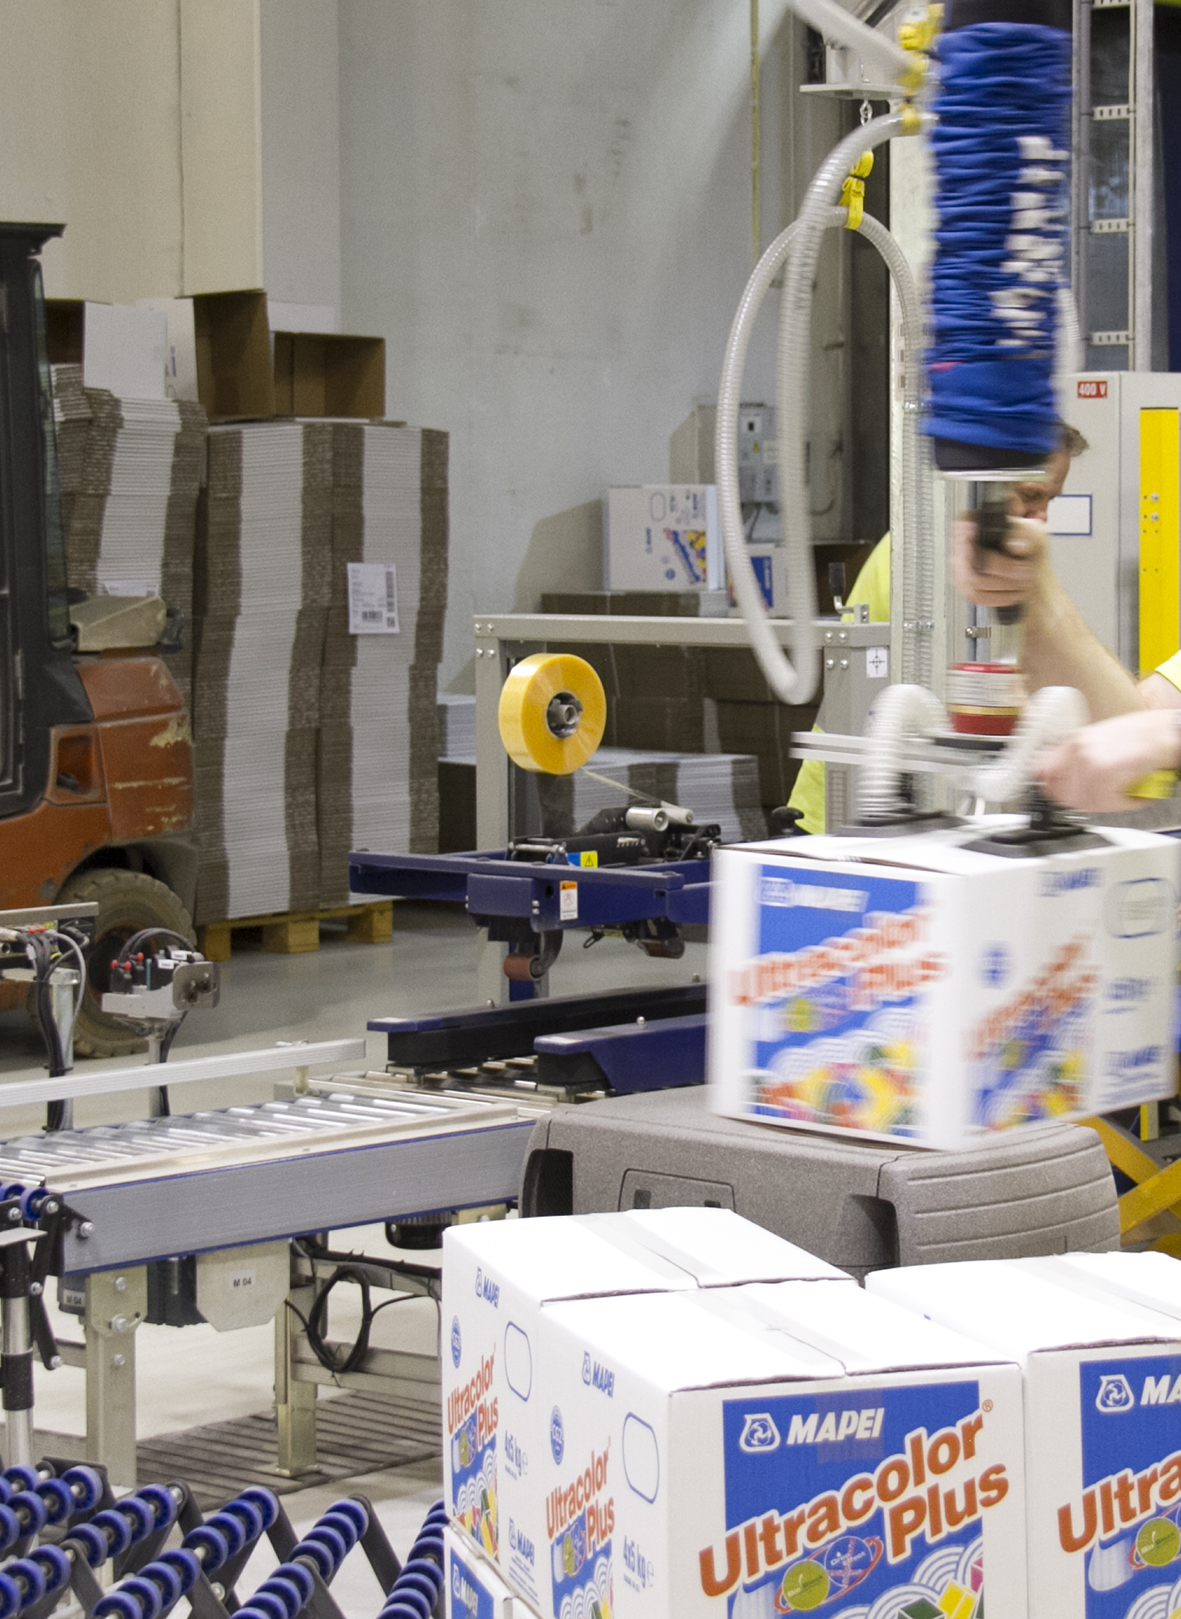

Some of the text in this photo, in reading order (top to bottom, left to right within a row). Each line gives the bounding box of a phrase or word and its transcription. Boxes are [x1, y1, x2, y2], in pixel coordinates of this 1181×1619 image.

[1078, 383, 1107, 396] 400 V
[447, 1355, 495, 1434] Ultracolor
[592, 1360, 615, 1398] MAPEI
[477, 1396, 499, 1452] Plus
[786, 1407, 885, 1445] MAPEI
[546, 1449, 609, 1540] Ultracolor
[699, 1412, 983, 1597] Ultracolor
[886, 1462, 1010, 1560] Plus
[586, 1497, 615, 1554] Plus
